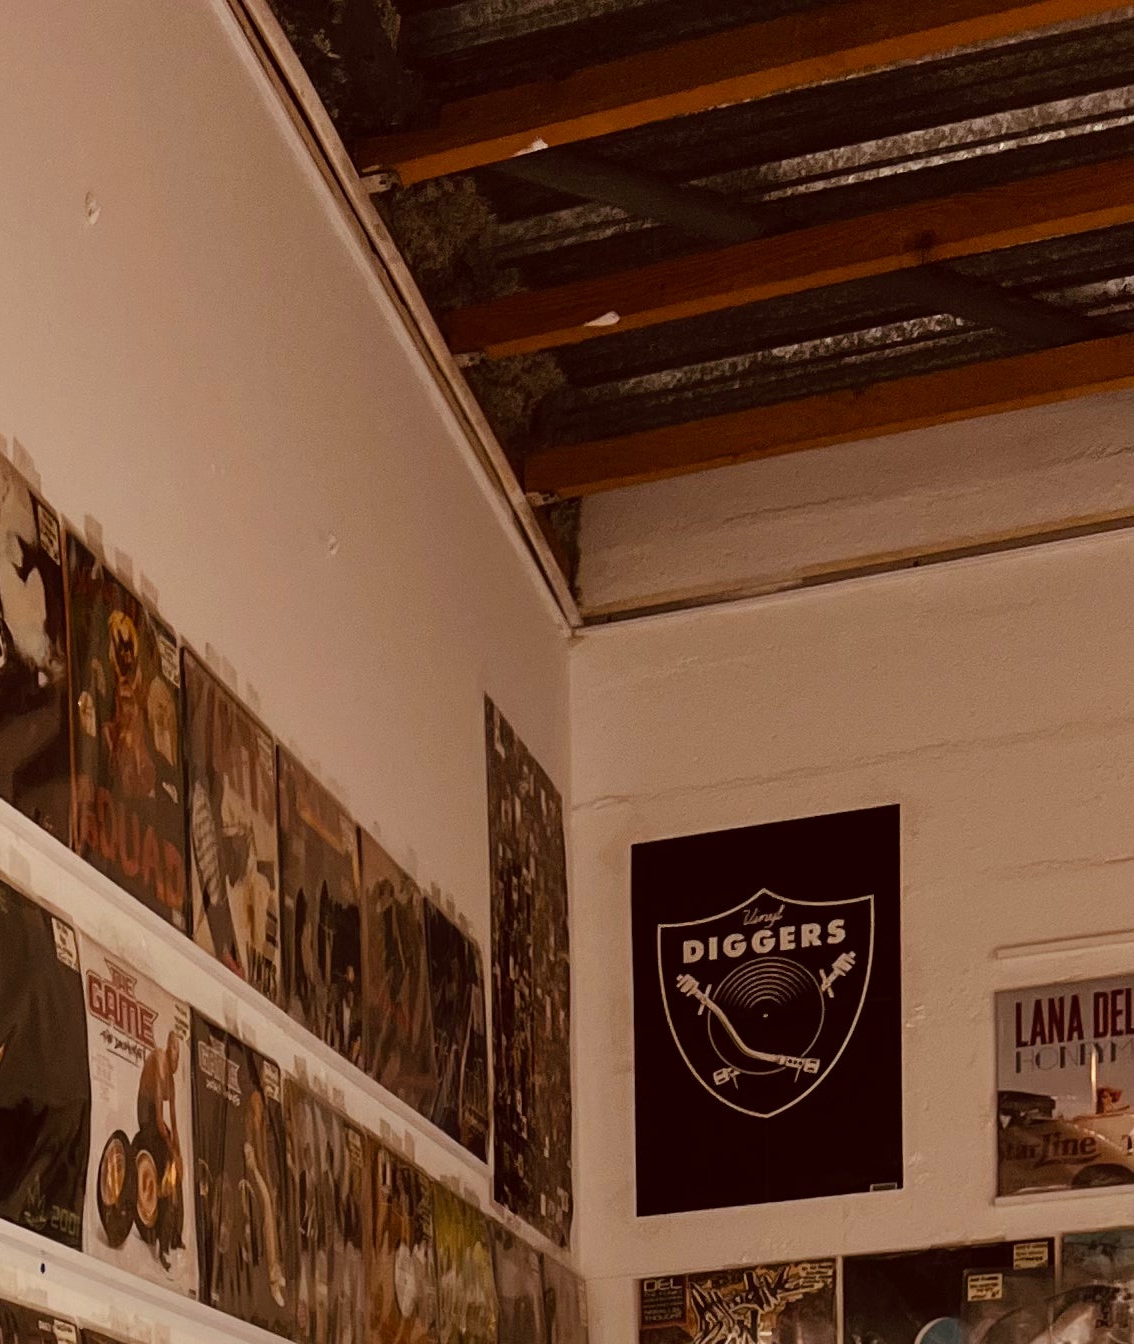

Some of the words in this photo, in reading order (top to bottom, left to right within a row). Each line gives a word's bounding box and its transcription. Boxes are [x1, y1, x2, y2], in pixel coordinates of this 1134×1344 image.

[683, 919, 847, 964] DIGGERS
[86, 970, 159, 1049] GAME
[1015, 994, 1084, 1048] LANA
[1093, 987, 1134, 1039] DEL
[644, 1279, 683, 1292] DEL
